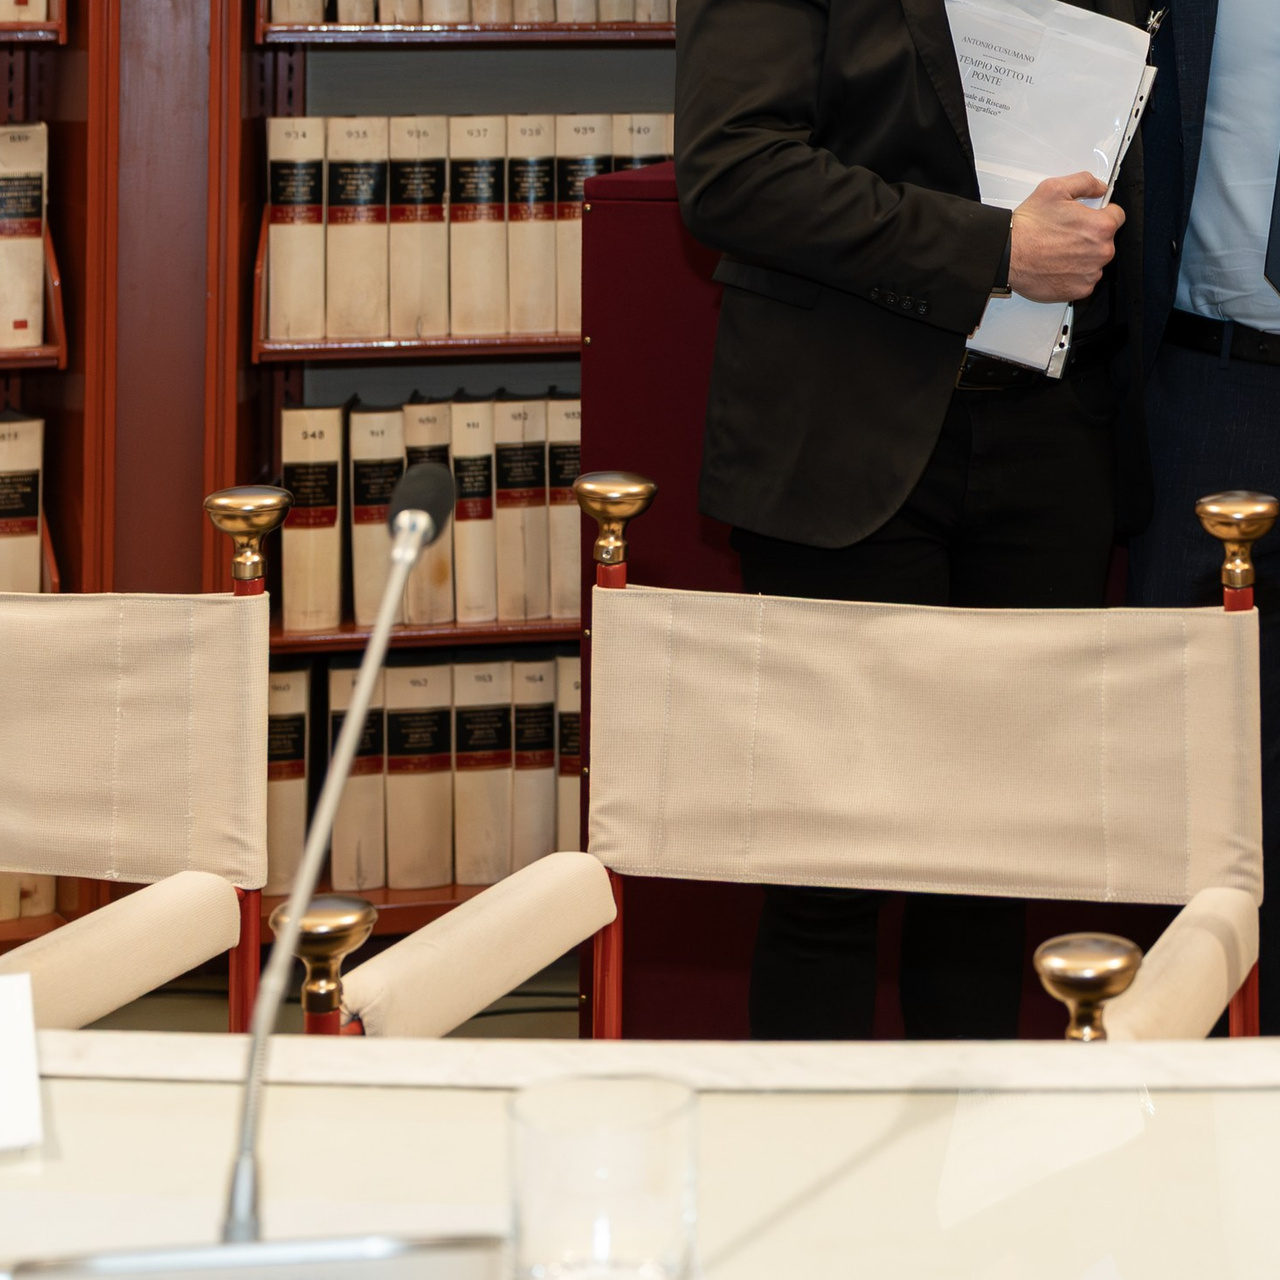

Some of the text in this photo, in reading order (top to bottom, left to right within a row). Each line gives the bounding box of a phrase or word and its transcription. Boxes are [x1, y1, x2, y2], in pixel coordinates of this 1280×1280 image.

[961, 36, 1035, 63] ANTONIO CUSUMANO
[959, 54, 992, 71] TEMPIO
[993, 65, 1024, 81] SOTTO
[971, 70, 1002, 86] PONTE
